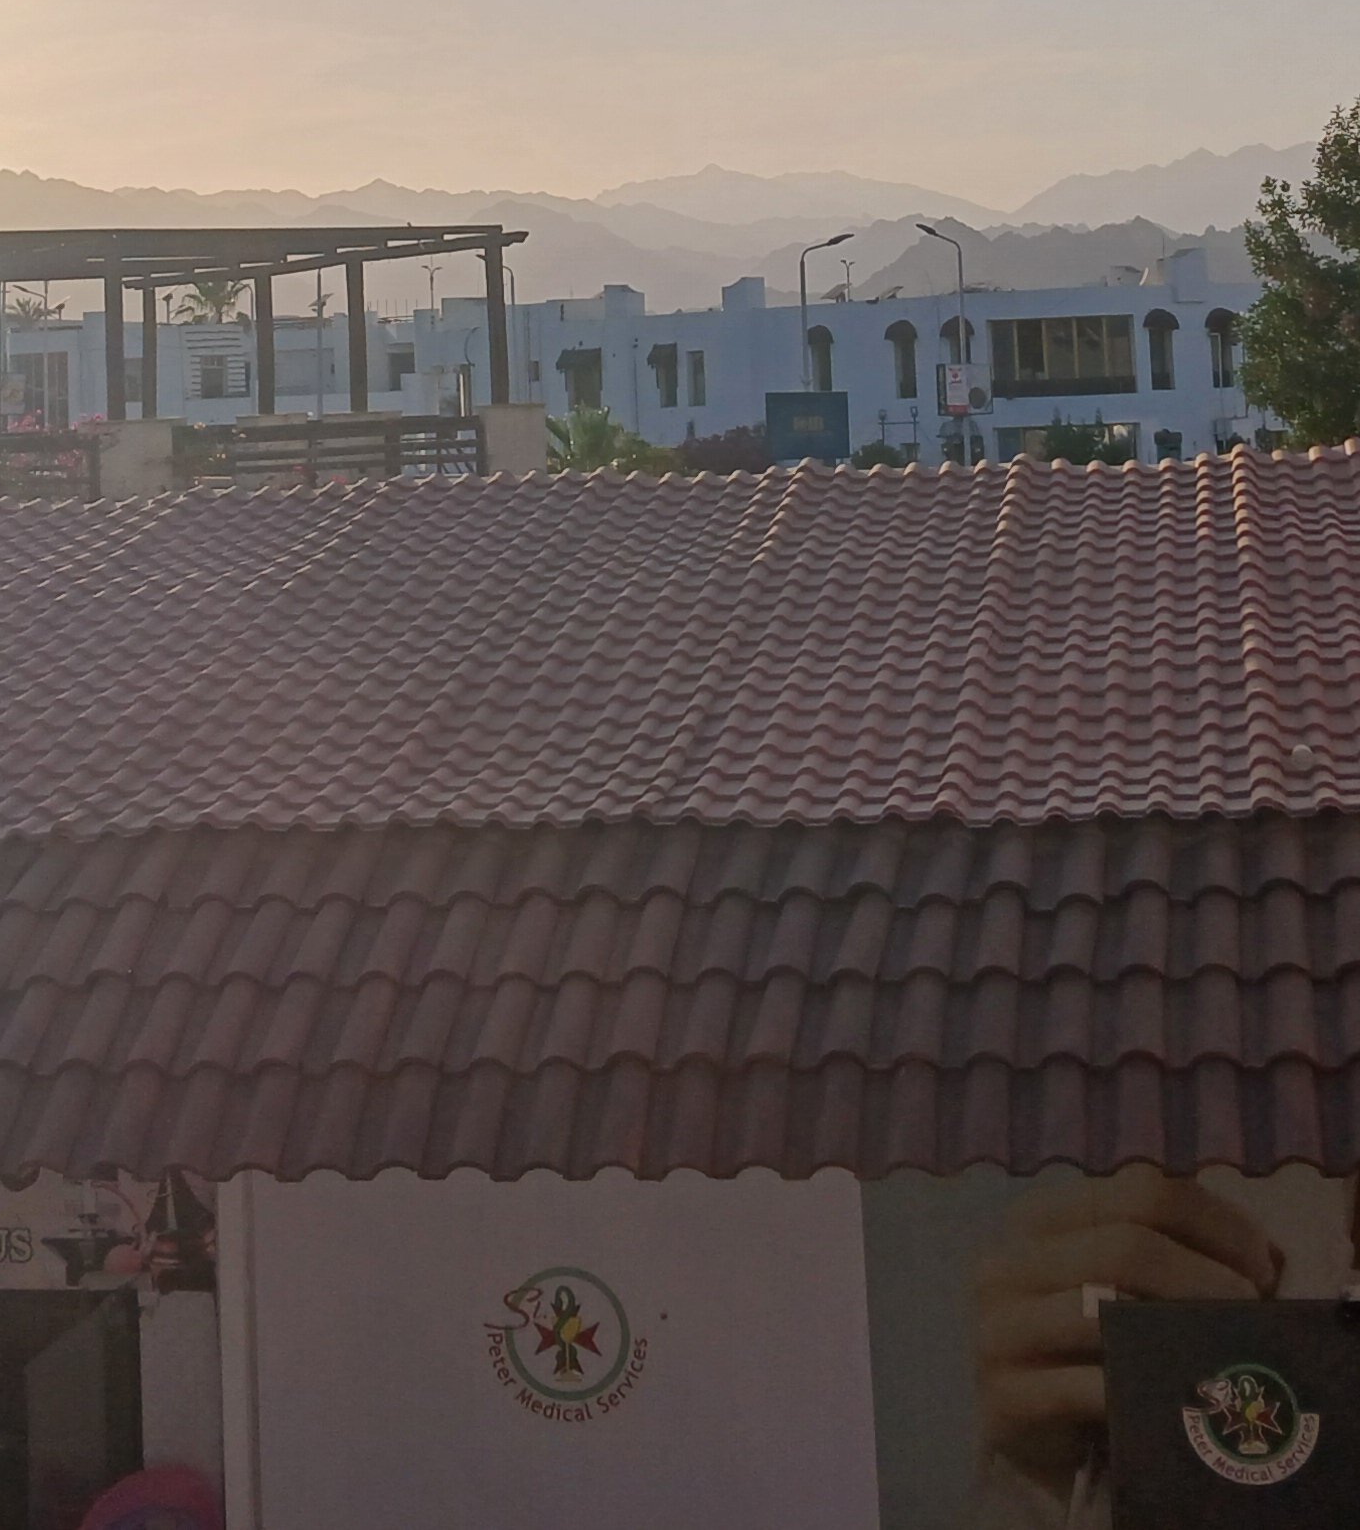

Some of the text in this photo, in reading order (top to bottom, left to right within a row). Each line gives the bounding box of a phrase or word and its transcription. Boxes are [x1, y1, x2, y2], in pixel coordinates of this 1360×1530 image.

[486, 1332, 649, 1422] Peter Medical Services
[1187, 1414, 1316, 1482] Peter Medical Services
